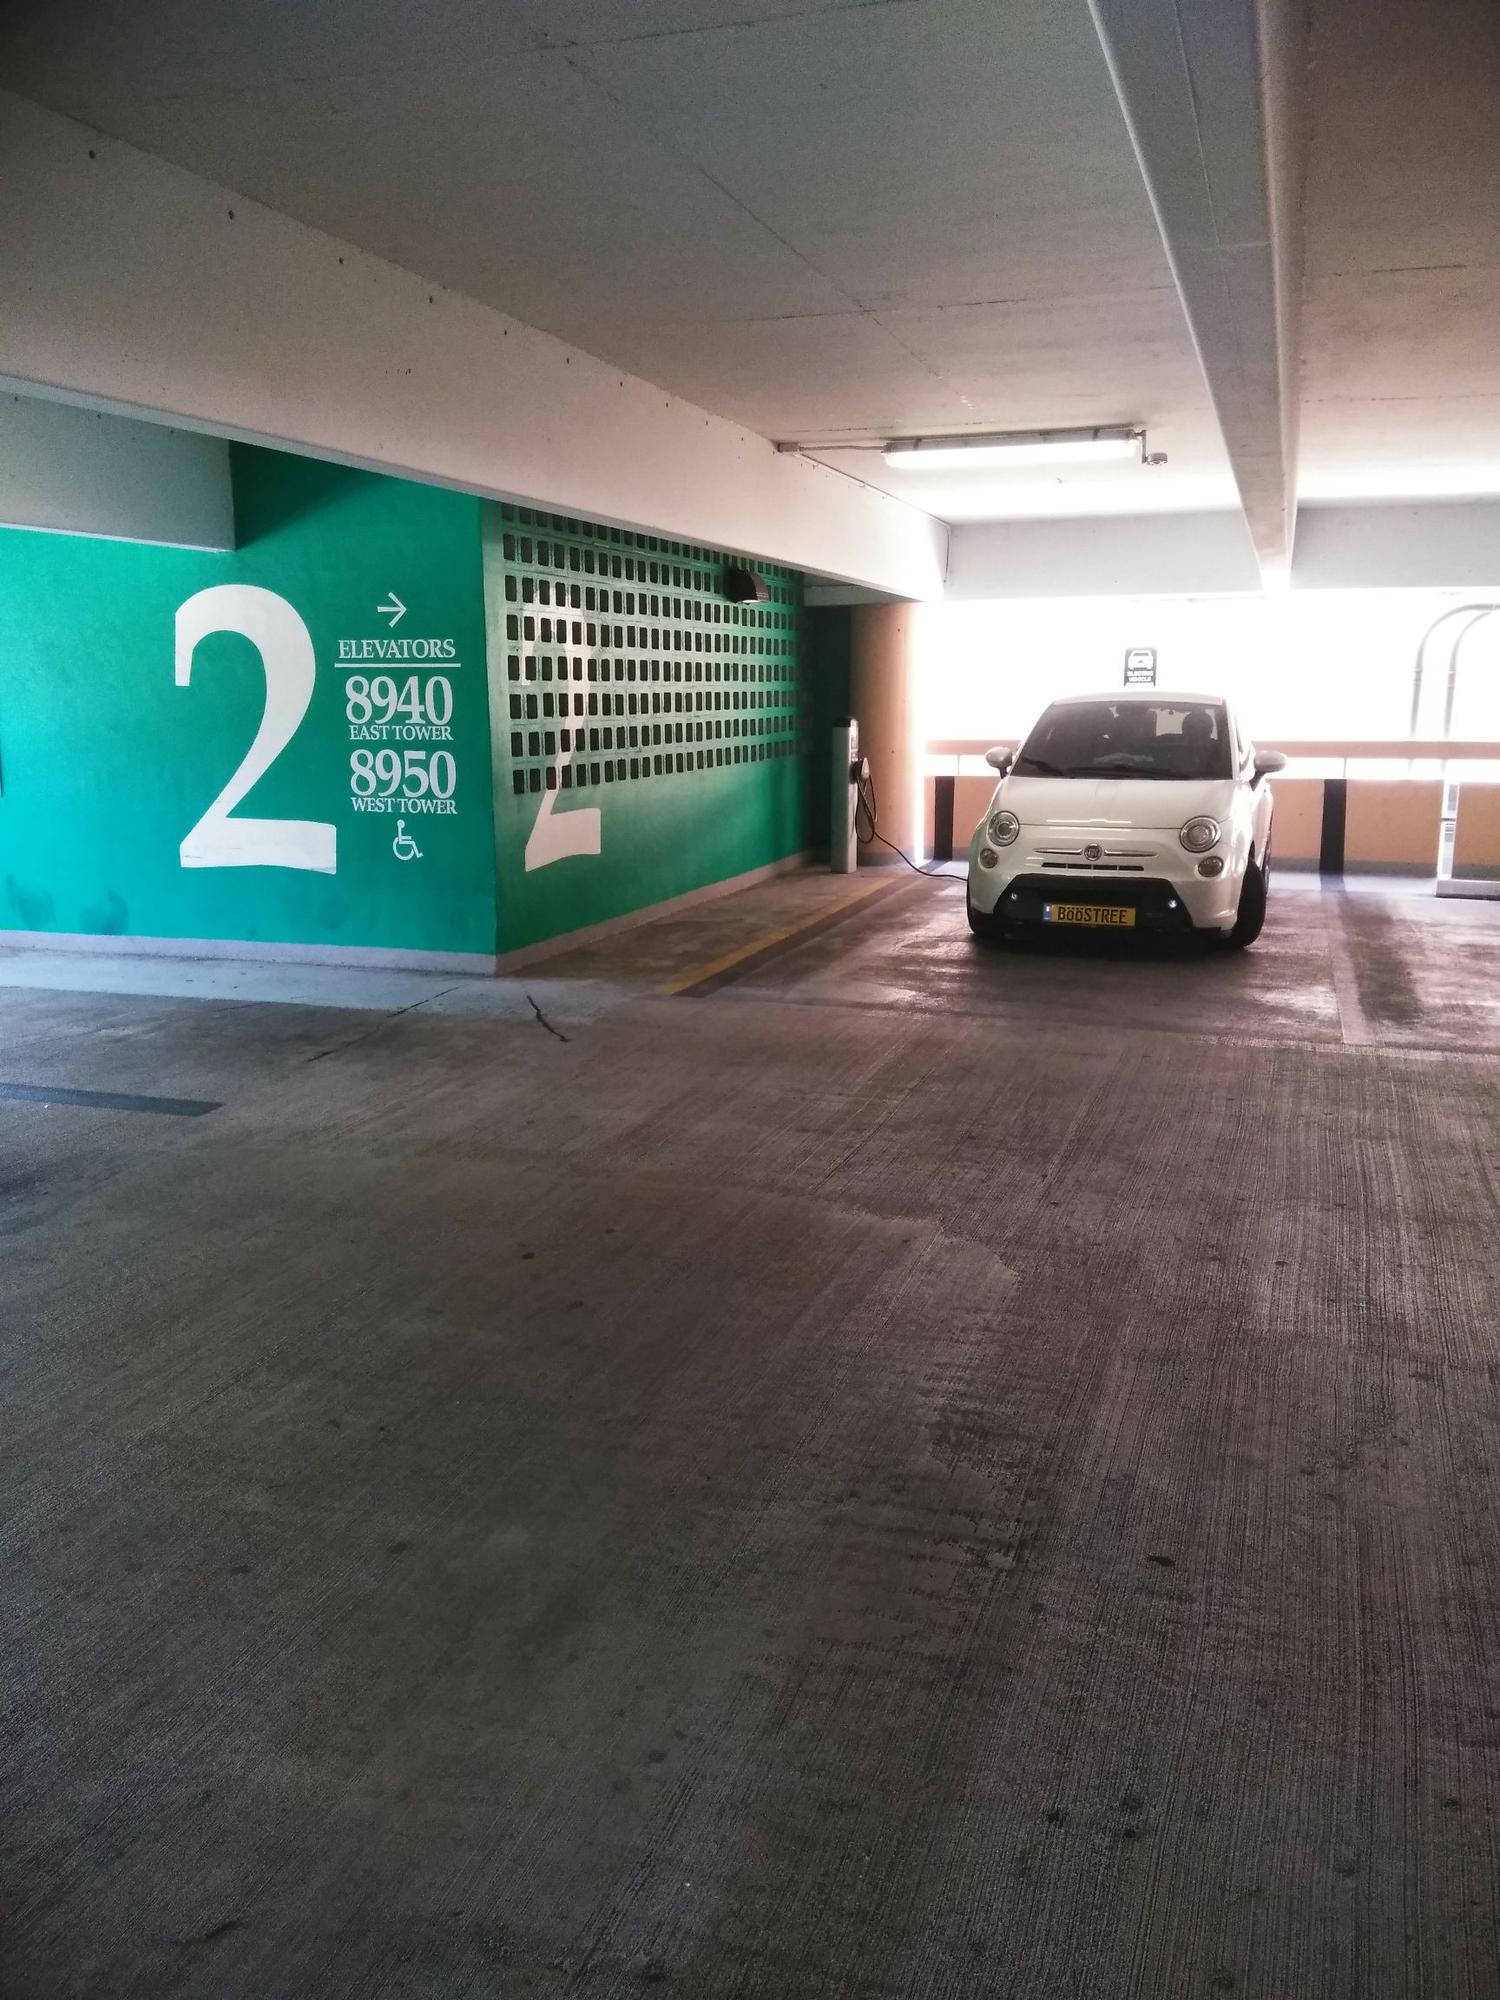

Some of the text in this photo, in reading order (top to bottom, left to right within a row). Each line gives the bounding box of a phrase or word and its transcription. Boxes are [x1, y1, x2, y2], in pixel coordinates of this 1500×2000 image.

[338, 639, 456, 659] ELEVATORS
[345, 675, 453, 726] 8940
[175, 584, 337, 875] 2
[349, 725, 454, 741] EAST TOWER
[522, 586, 601, 872] 2
[350, 749, 457, 799] 8950
[350, 797, 458, 815] WEST TOWER
